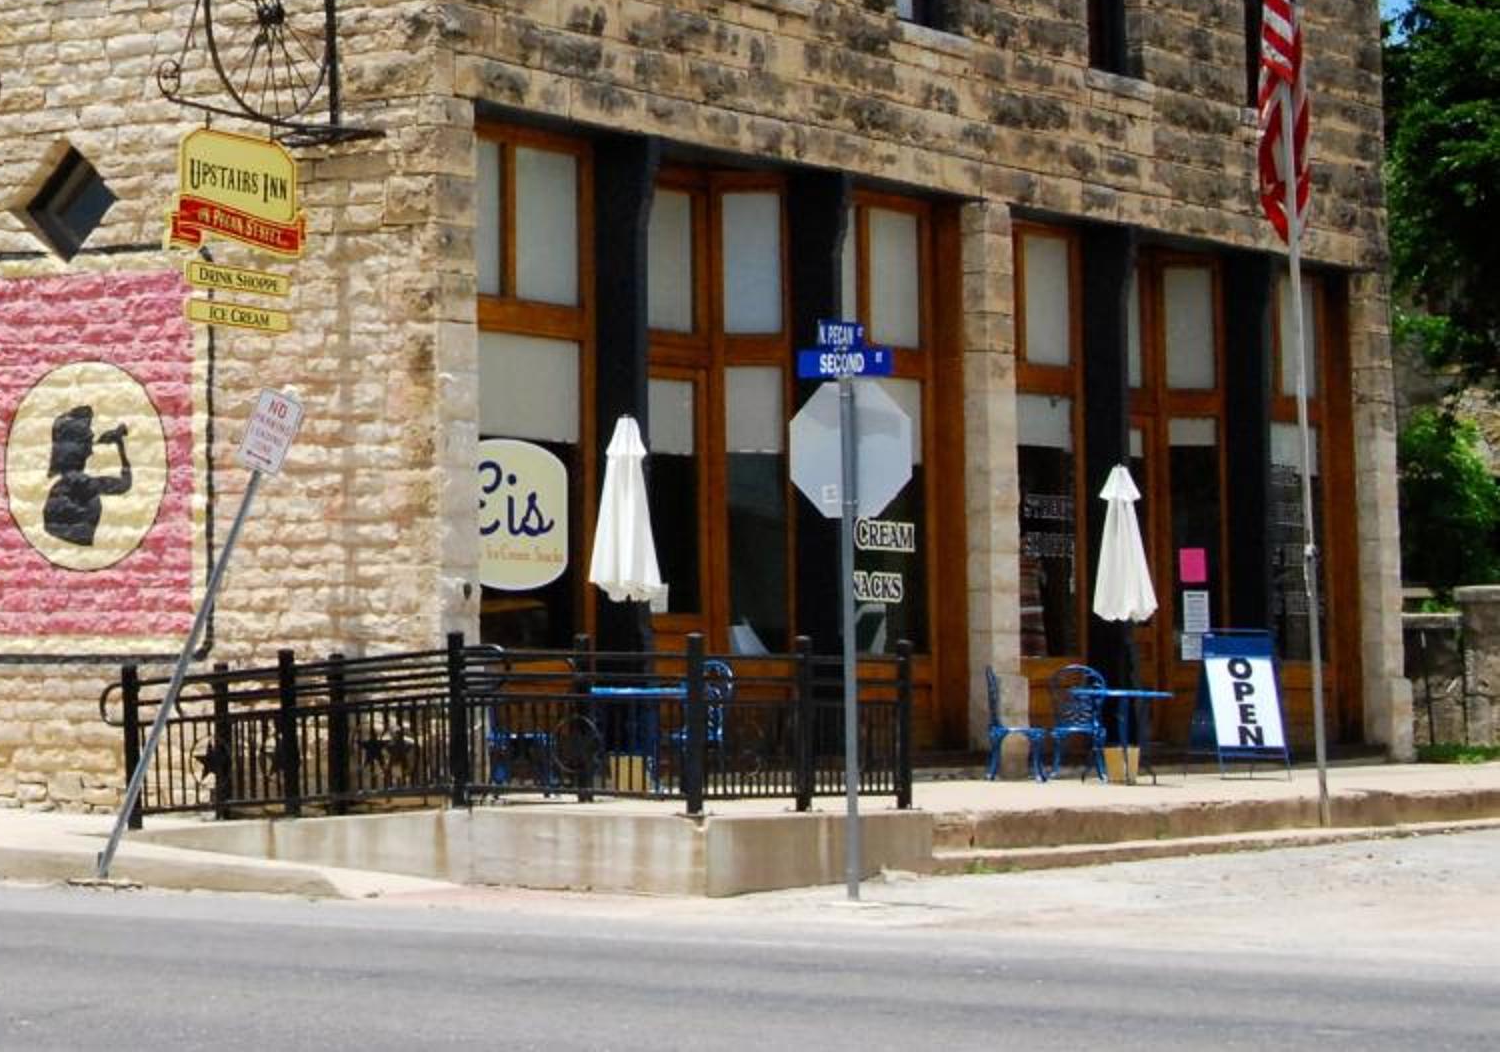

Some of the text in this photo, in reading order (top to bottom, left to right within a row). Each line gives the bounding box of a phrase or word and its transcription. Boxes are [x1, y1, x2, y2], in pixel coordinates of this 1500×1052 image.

[190, 158, 287, 203] UPSTAIRS INN
[209, 306, 270, 327] ICE CREAM
[819, 352, 865, 374] SECOND
[268, 398, 289, 419] NO
[856, 519, 914, 548] CREAM
[1227, 657, 1265, 747] OPEN
